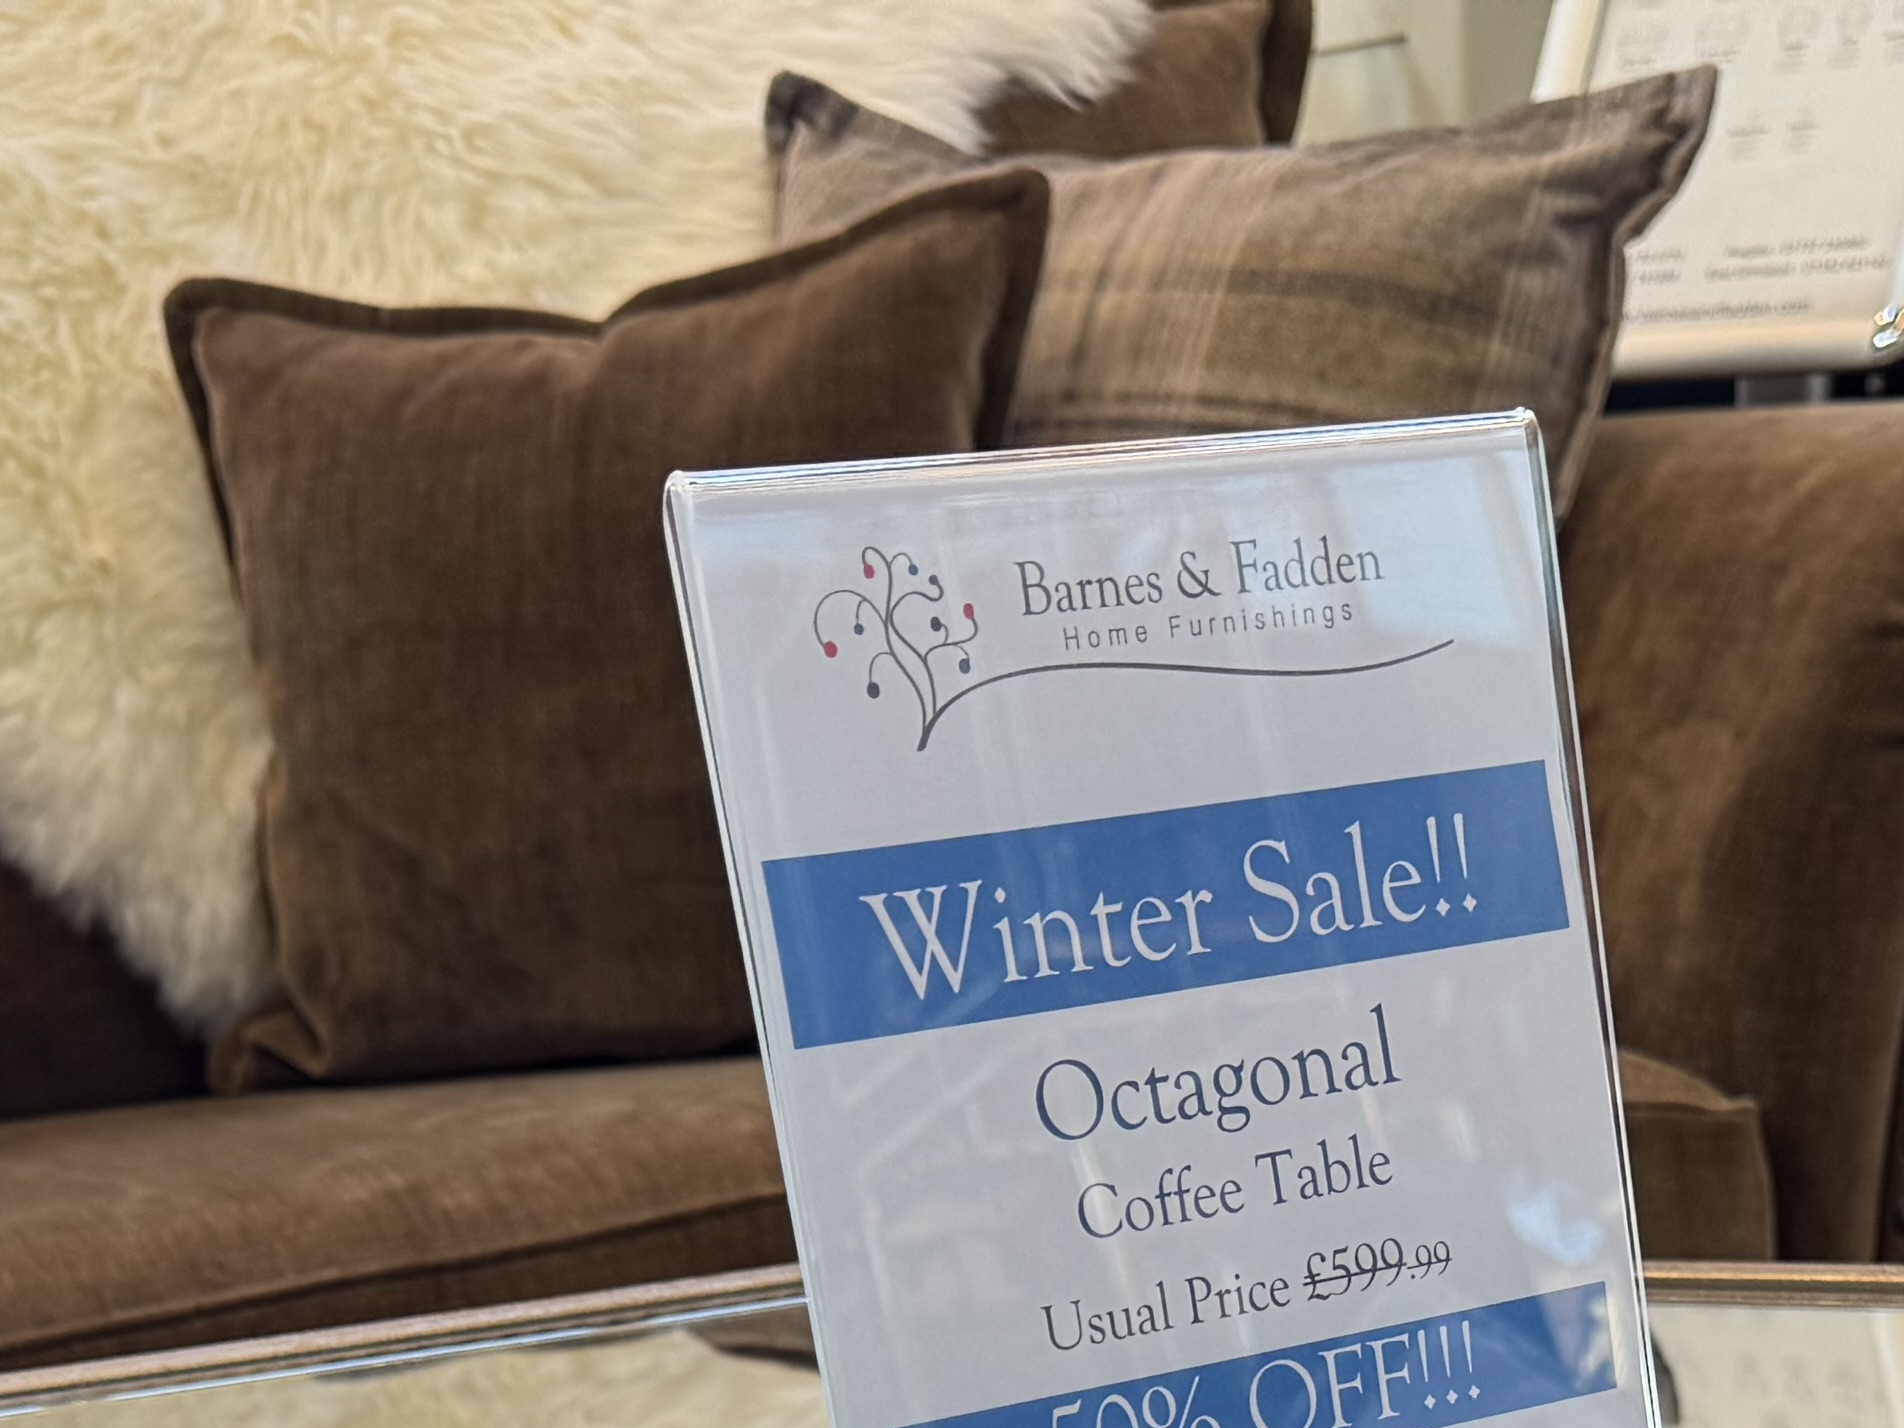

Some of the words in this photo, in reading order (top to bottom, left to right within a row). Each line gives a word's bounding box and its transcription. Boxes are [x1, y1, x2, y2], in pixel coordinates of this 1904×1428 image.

[1013, 560, 1163, 616] Barnes
[1176, 551, 1222, 600] &
[1230, 535, 1385, 594] Fadden
[1063, 621, 1148, 651] Home
[1168, 602, 1354, 639] Furnishings
[859, 880, 1214, 1000] Winter
[1242, 813, 1478, 944] Sale!!
[1035, 1002, 1402, 1141] Octagonal
[1077, 1164, 1245, 1238] Coffee
[1254, 1133, 1394, 1206] Table
[1041, 1281, 1174, 1351] Usual
[1185, 1273, 1291, 1325] Price
[1302, 1237, 1452, 1301] £599.99
